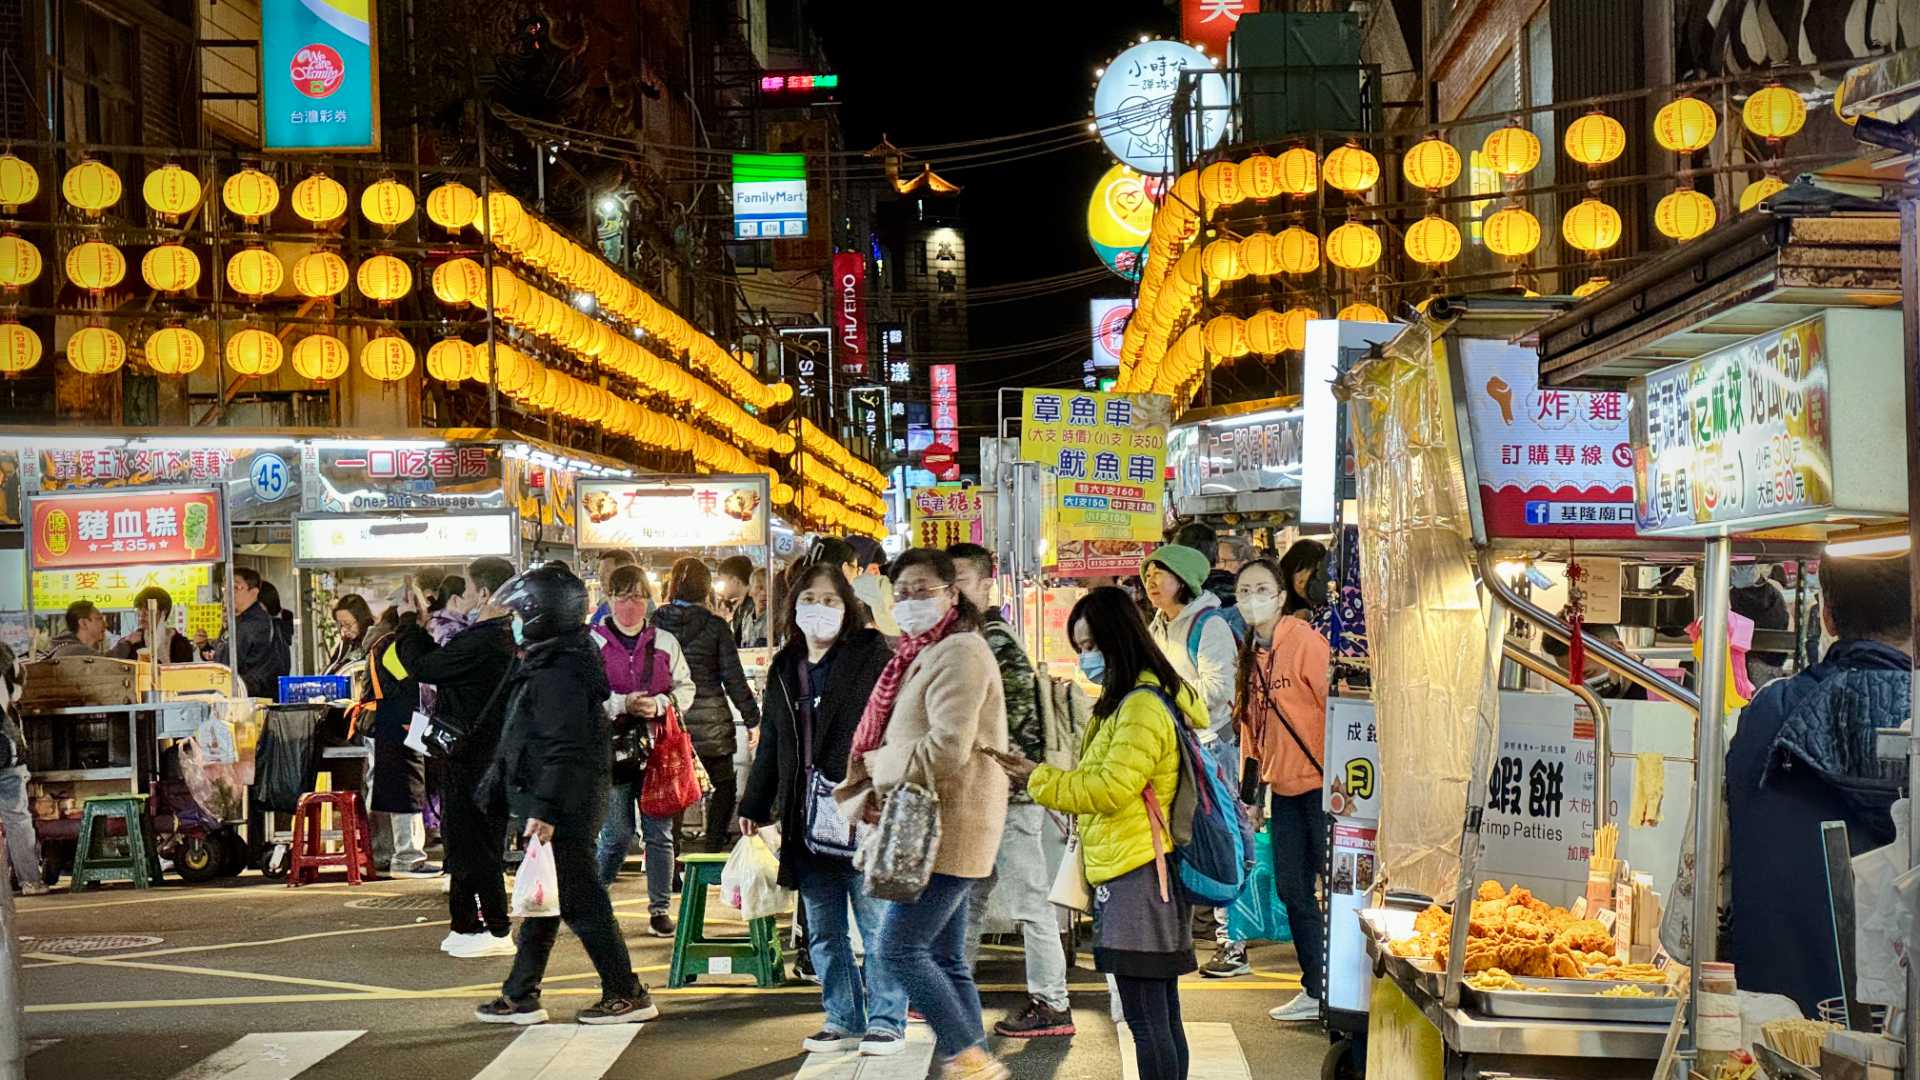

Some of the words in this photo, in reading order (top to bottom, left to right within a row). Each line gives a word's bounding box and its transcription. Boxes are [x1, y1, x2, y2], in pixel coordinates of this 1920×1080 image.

[291, 110, 347, 124] 台灣彩券
[737, 191, 804, 205] FamilyMart
[842, 274, 859, 354] SHISEIDO
[1032, 395, 1133, 426] 章魚串
[1537, 390, 1621, 420] 炸雞
[336, 448, 488, 477] 一口吃香腸
[1057, 449, 1156, 484] 魷魚串
[1501, 444, 1602, 466] 訂購專線
[258, 463, 282, 493] 45
[353, 494, 411, 508] One-Bite
[421, 494, 476, 509] Sausage
[1561, 506, 1634, 521] 基隆廟口
[78, 507, 178, 540] 豬血糕
[778, 538, 793, 551] 25
[96, 593, 112, 603] 50
[1346, 758, 1374, 799] 月
[1488, 757, 1564, 817] 蝦餅
[1481, 818, 1510, 840] rimp
[1514, 822, 1563, 842] Patties
